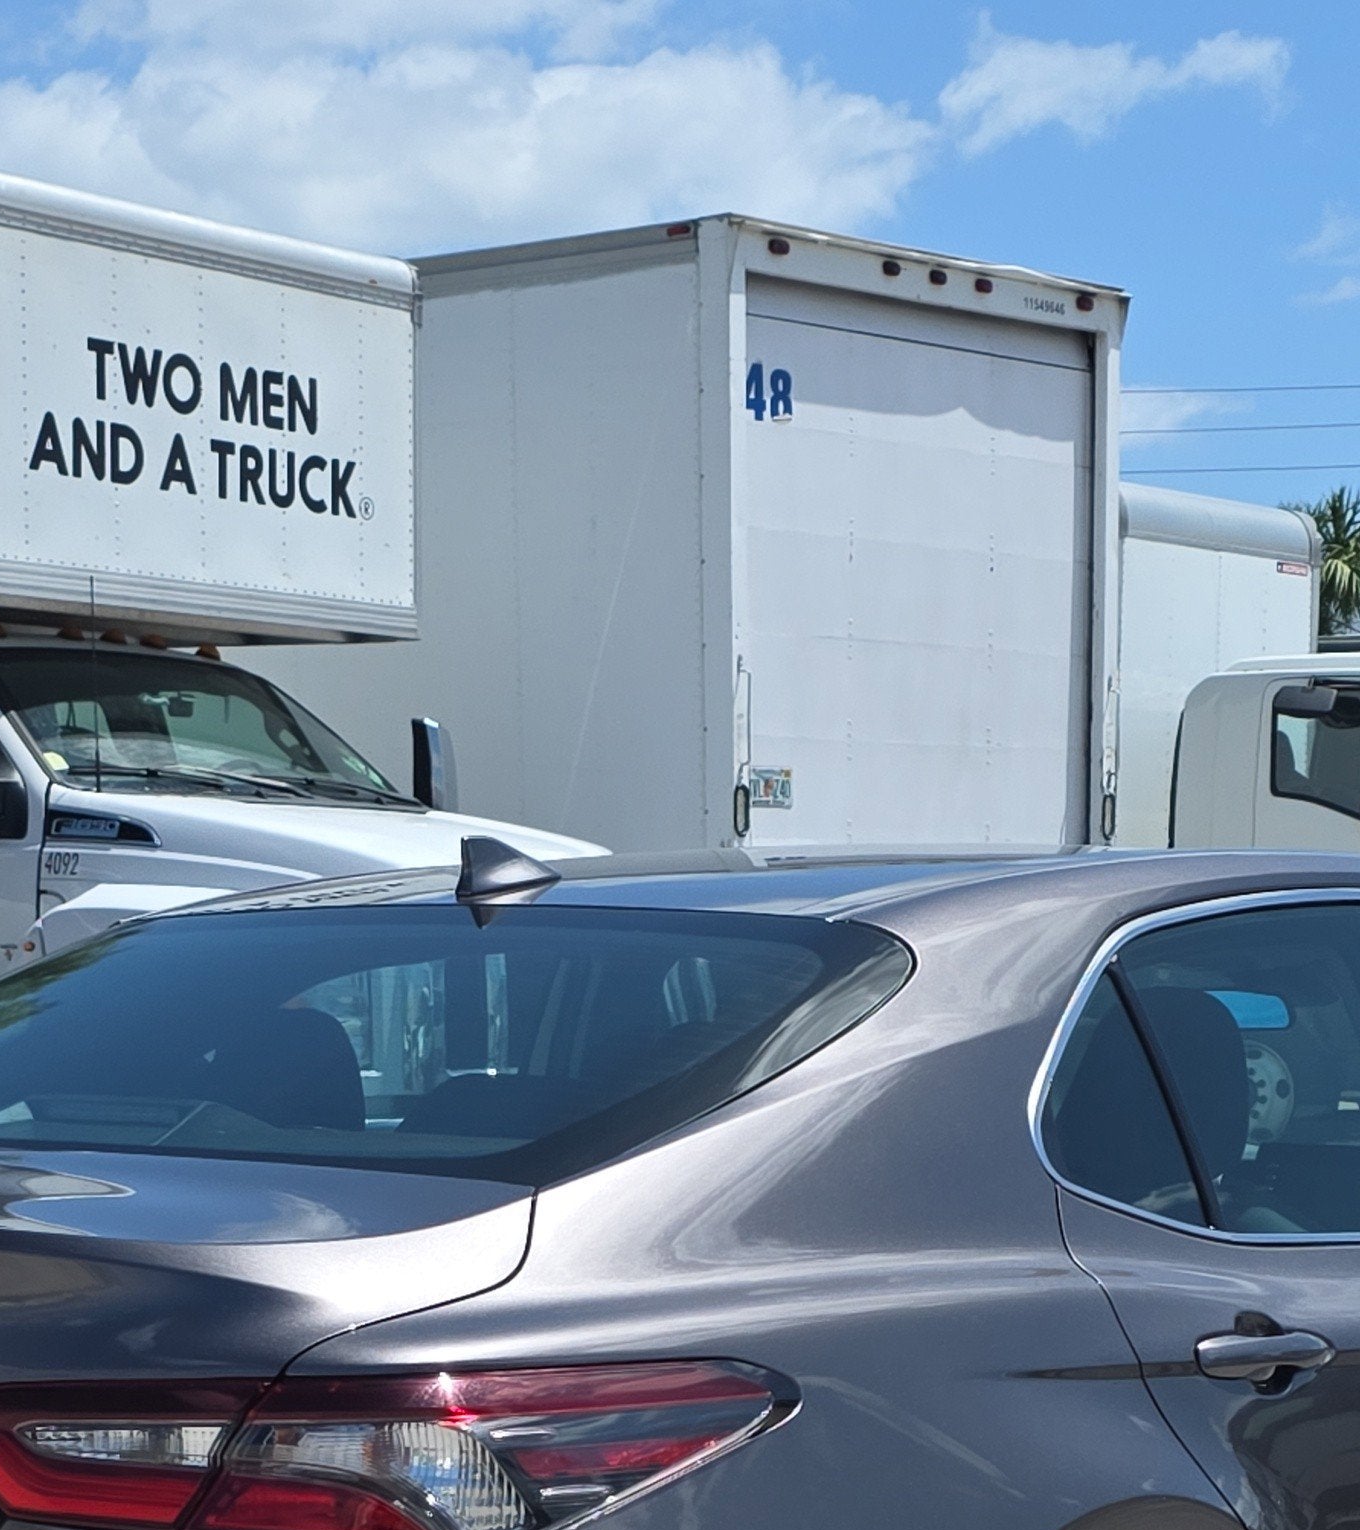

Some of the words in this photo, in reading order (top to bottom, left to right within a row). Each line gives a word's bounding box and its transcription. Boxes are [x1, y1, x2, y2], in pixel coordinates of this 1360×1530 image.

[87, 336, 202, 415] TWO
[219, 362, 317, 435] MEN
[745, 362, 793, 421] 48
[29, 411, 144, 485] AND
[160, 433, 197, 495] A
[44, 852, 79, 876] 4092
